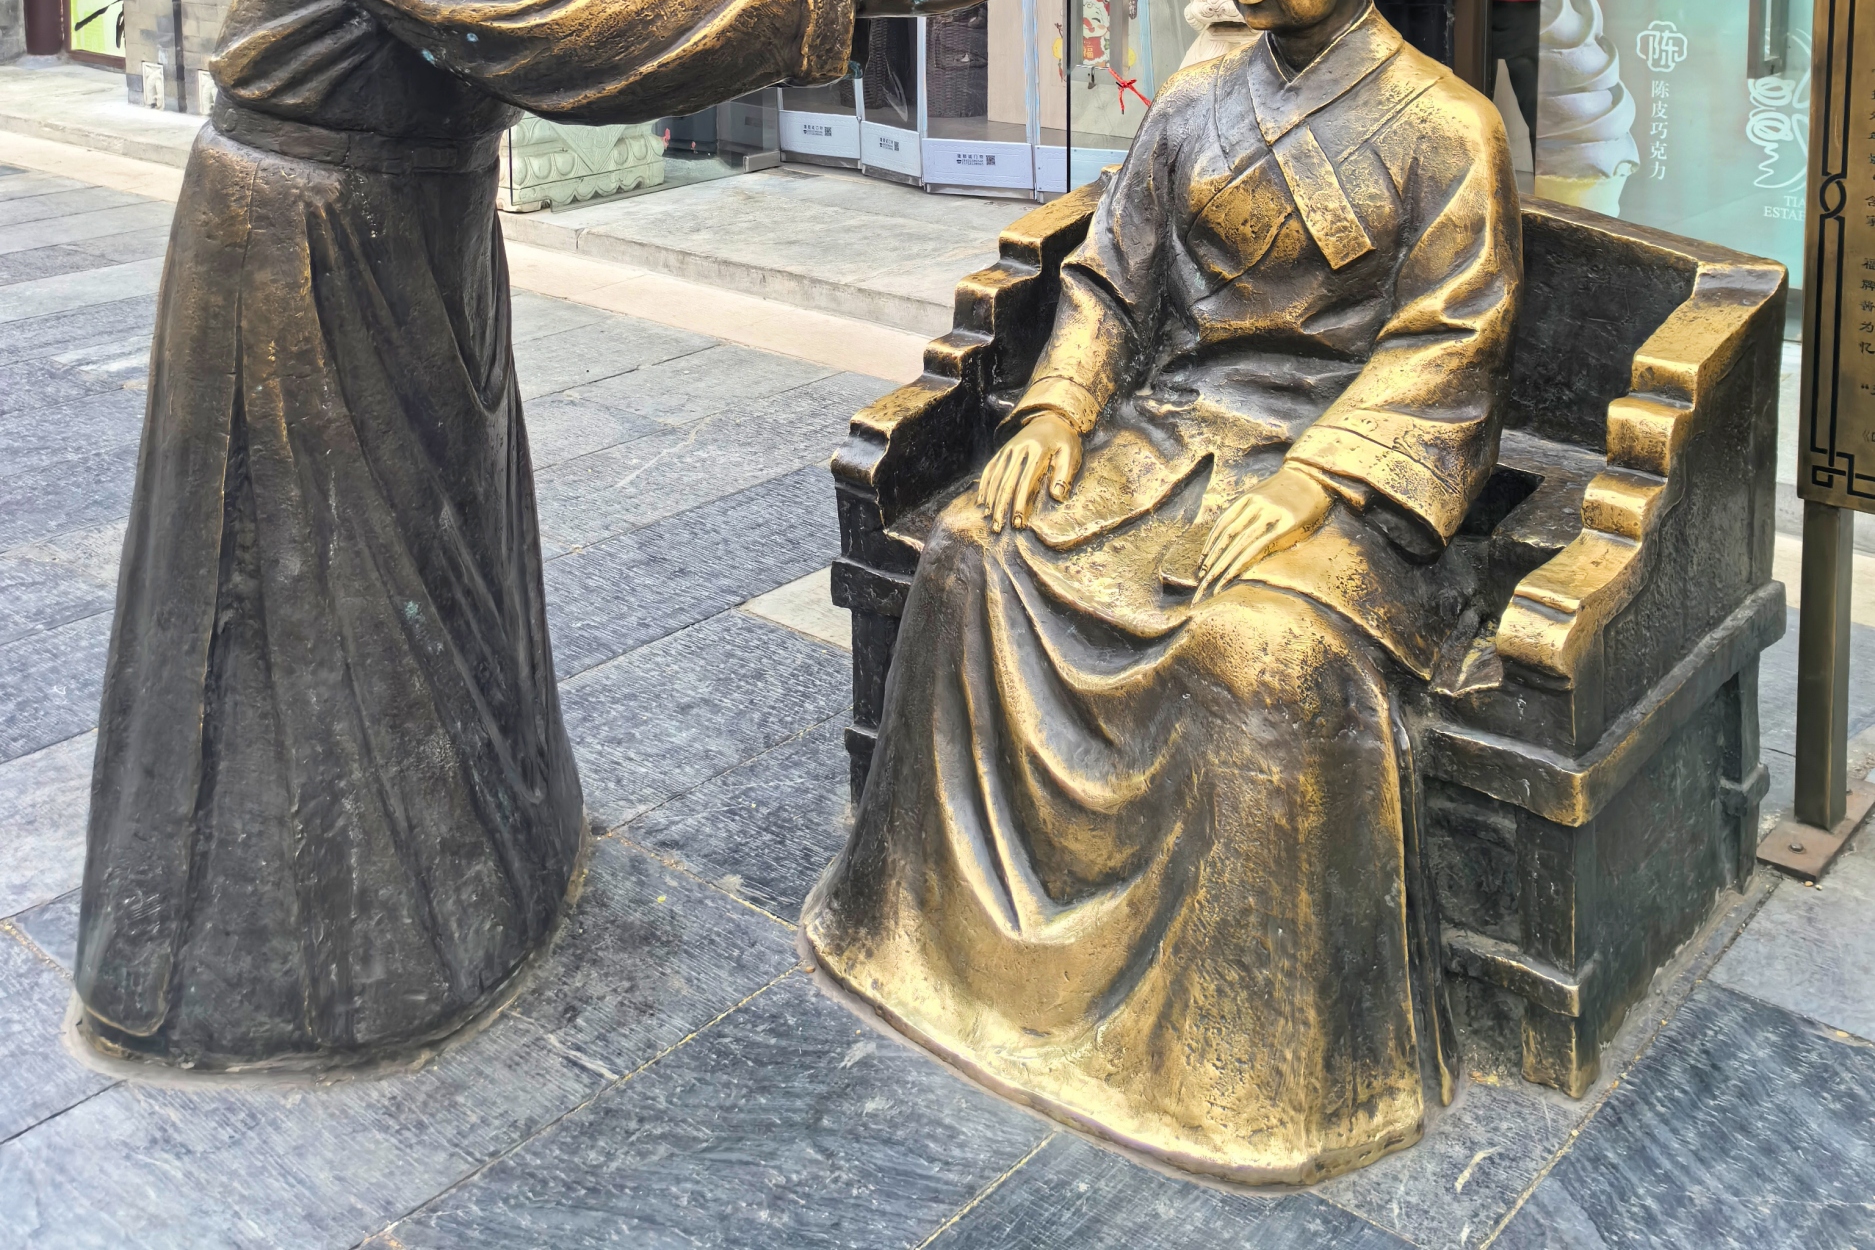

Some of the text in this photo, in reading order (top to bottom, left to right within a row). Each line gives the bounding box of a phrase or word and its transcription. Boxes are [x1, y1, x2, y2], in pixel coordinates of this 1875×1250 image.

[1649, 80, 1670, 180] 陈皮巧克力
